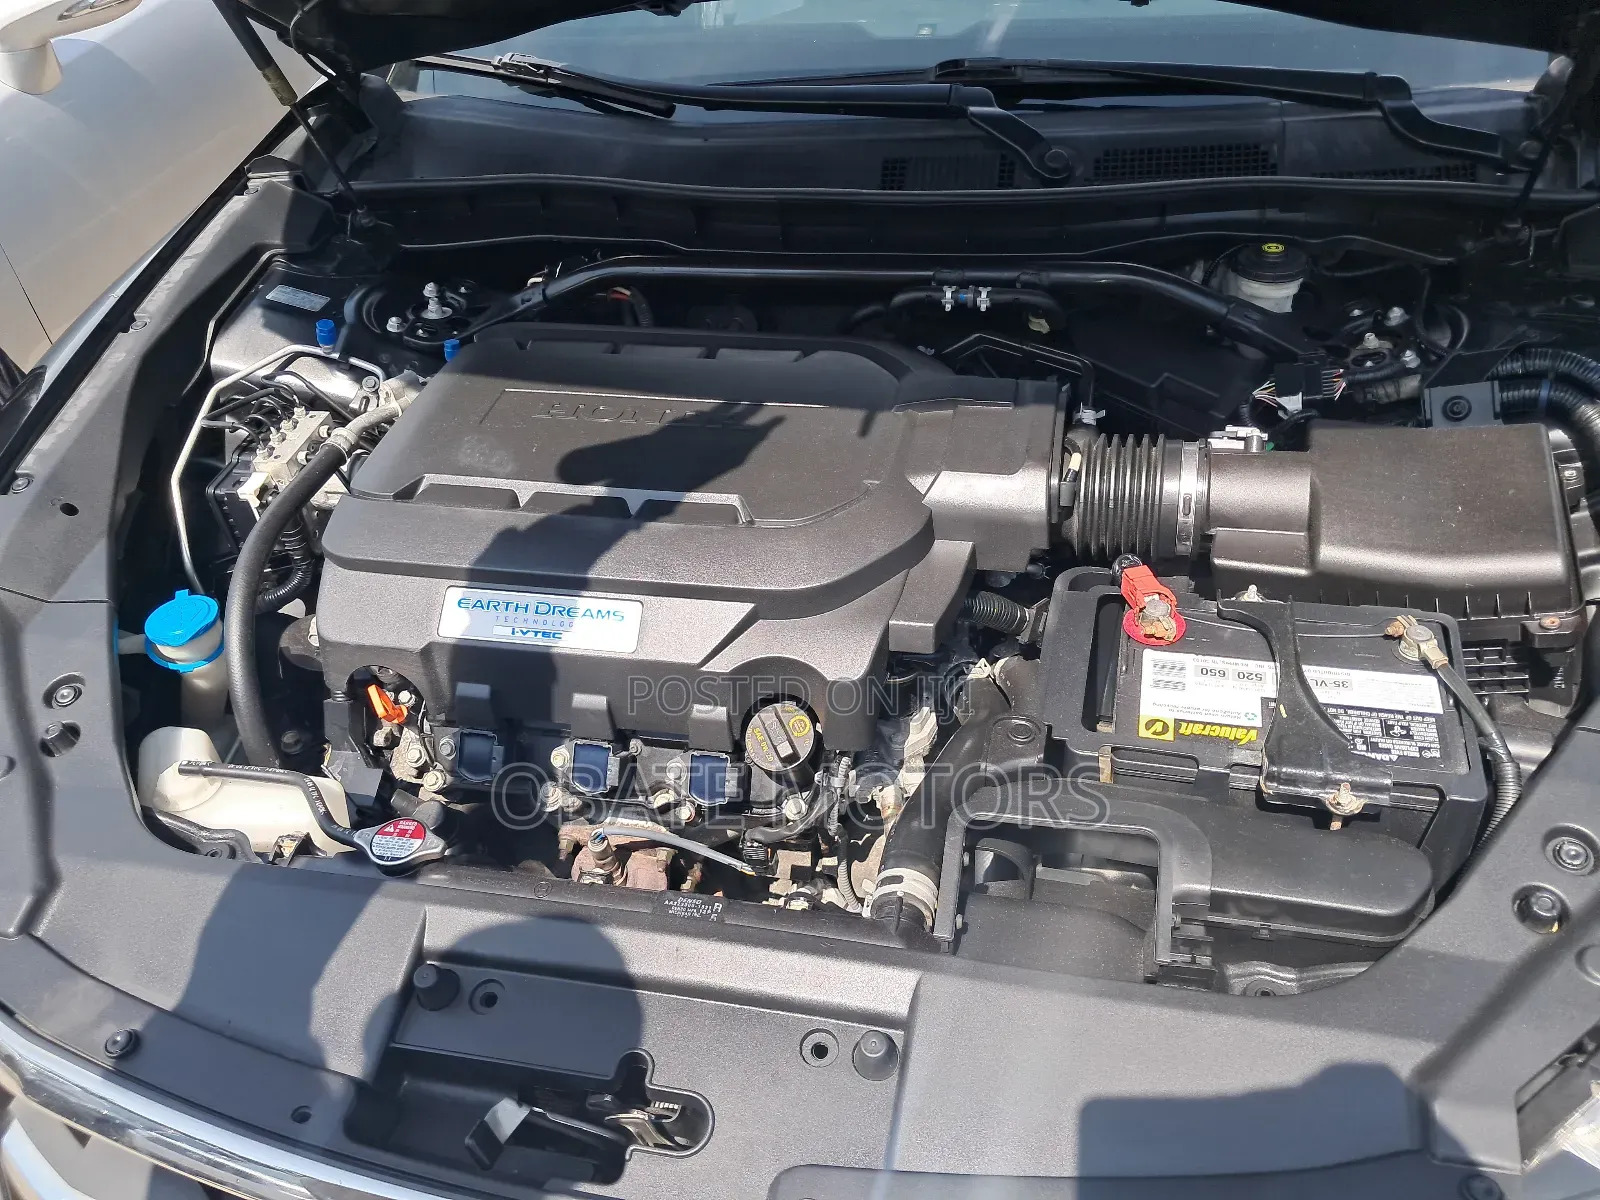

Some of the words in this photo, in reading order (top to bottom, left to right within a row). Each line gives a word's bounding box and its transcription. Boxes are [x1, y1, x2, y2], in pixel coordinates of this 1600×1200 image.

[457, 596, 530, 616] EARTH
[534, 600, 625, 623] DREAMS
[495, 615, 575, 629] TECHNOLOG
[1200, 667, 1226, 678] 650
[1237, 671, 1263, 682] 520
[1309, 678, 1350, 689] 35-VL
[753, 727, 763, 742] SAE
[1178, 721, 1258, 745] Valucraft
[677, 896, 702, 904] DENSO
